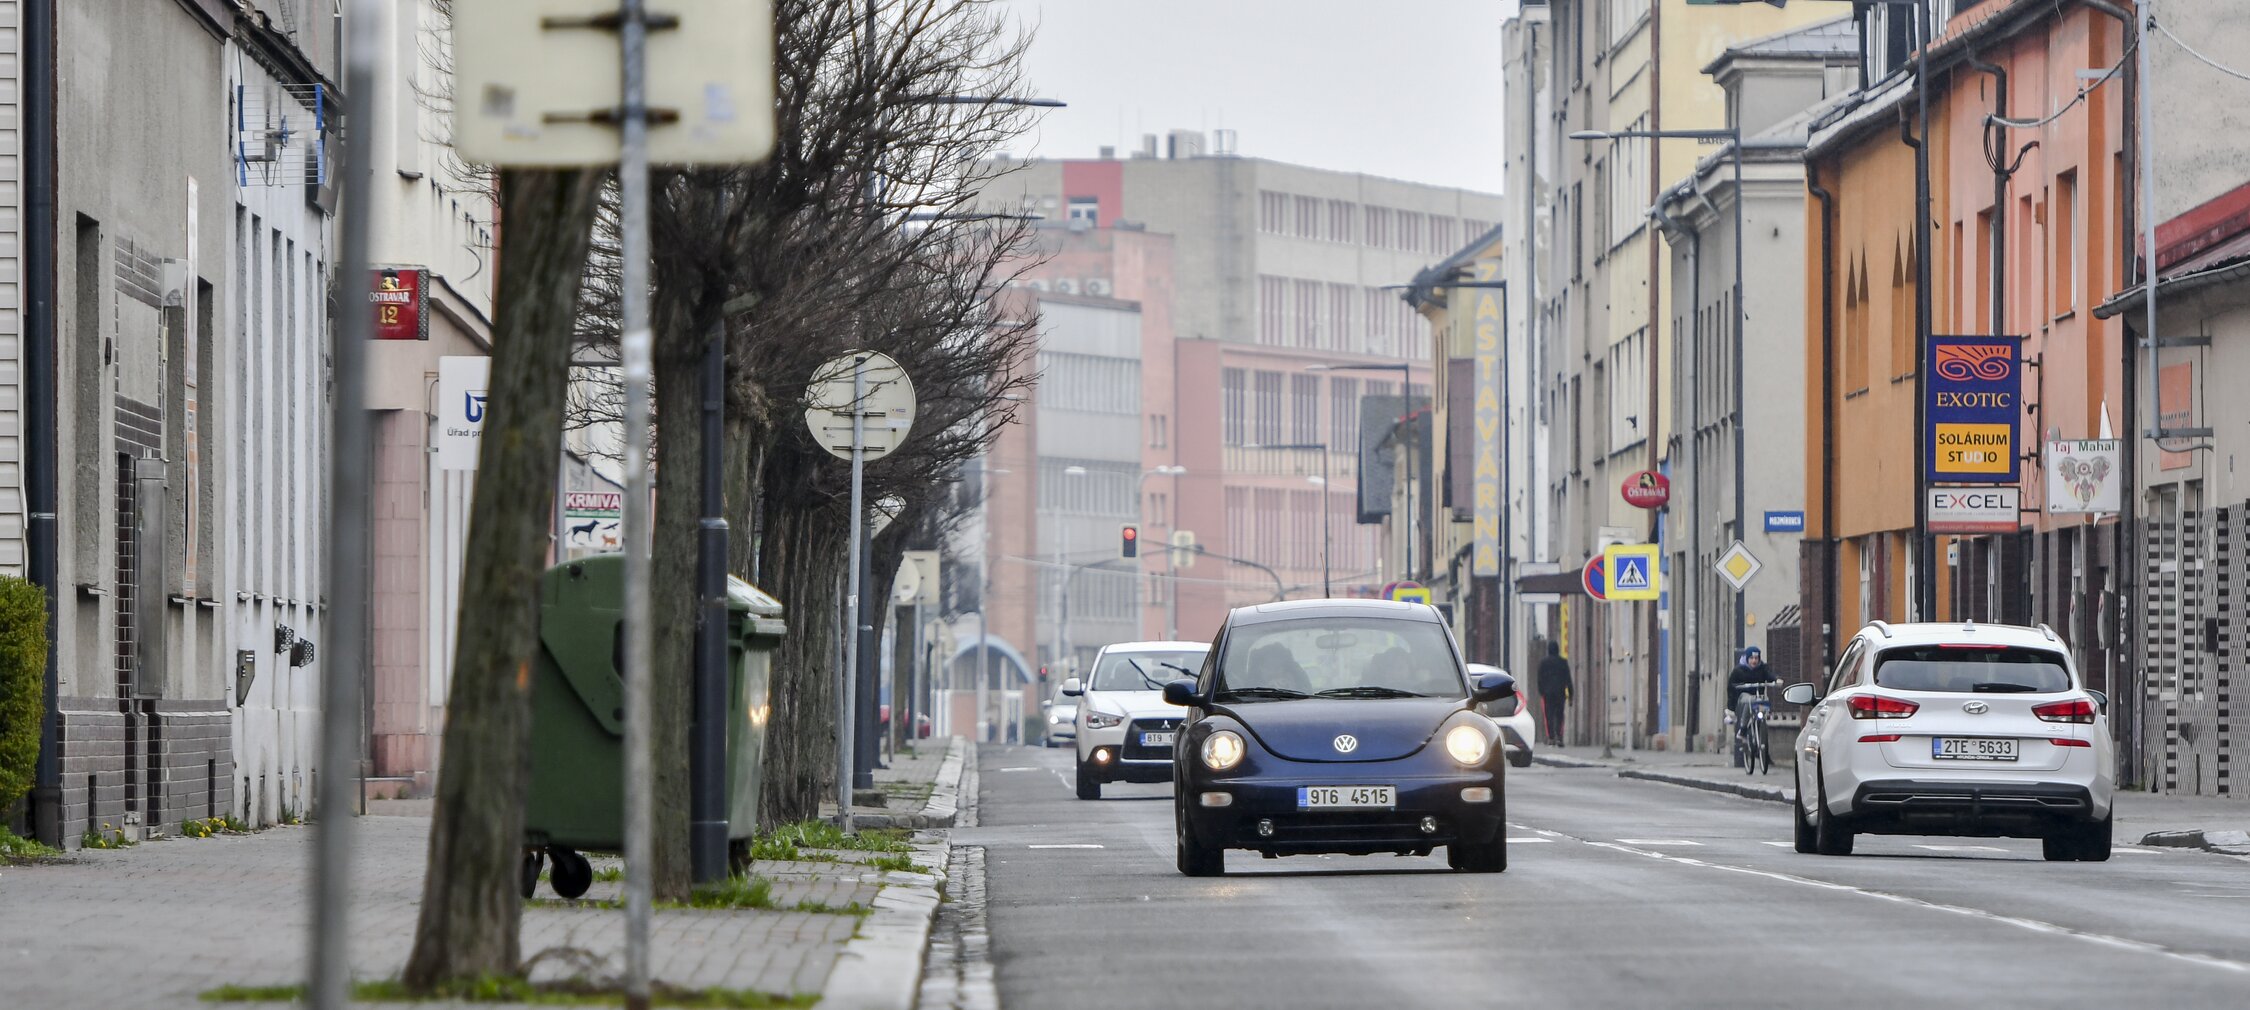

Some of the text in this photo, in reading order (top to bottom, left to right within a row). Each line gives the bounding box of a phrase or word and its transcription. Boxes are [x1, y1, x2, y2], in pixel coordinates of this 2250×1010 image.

[369, 292, 410, 303] OSTRAVAR
[380, 306, 398, 324] 12
[1936, 392, 2011, 408] EXOTIC
[1475, 263, 1499, 571] ZASTAVÁRNA
[447, 427, 469, 437] Úřad
[1938, 431, 2008, 446] SOLÁRIUM
[2054, 441, 2115, 454] Taj Mahal
[1948, 451, 1998, 464] STUDIO
[1627, 487, 1667, 498] OSTRAVAR
[565, 493, 621, 509] KRMIVA
[1934, 494, 2013, 509] EXCEL
[1944, 740, 2012, 755] 2TE 5633
[1310, 789, 1388, 805] 9T6 4515
